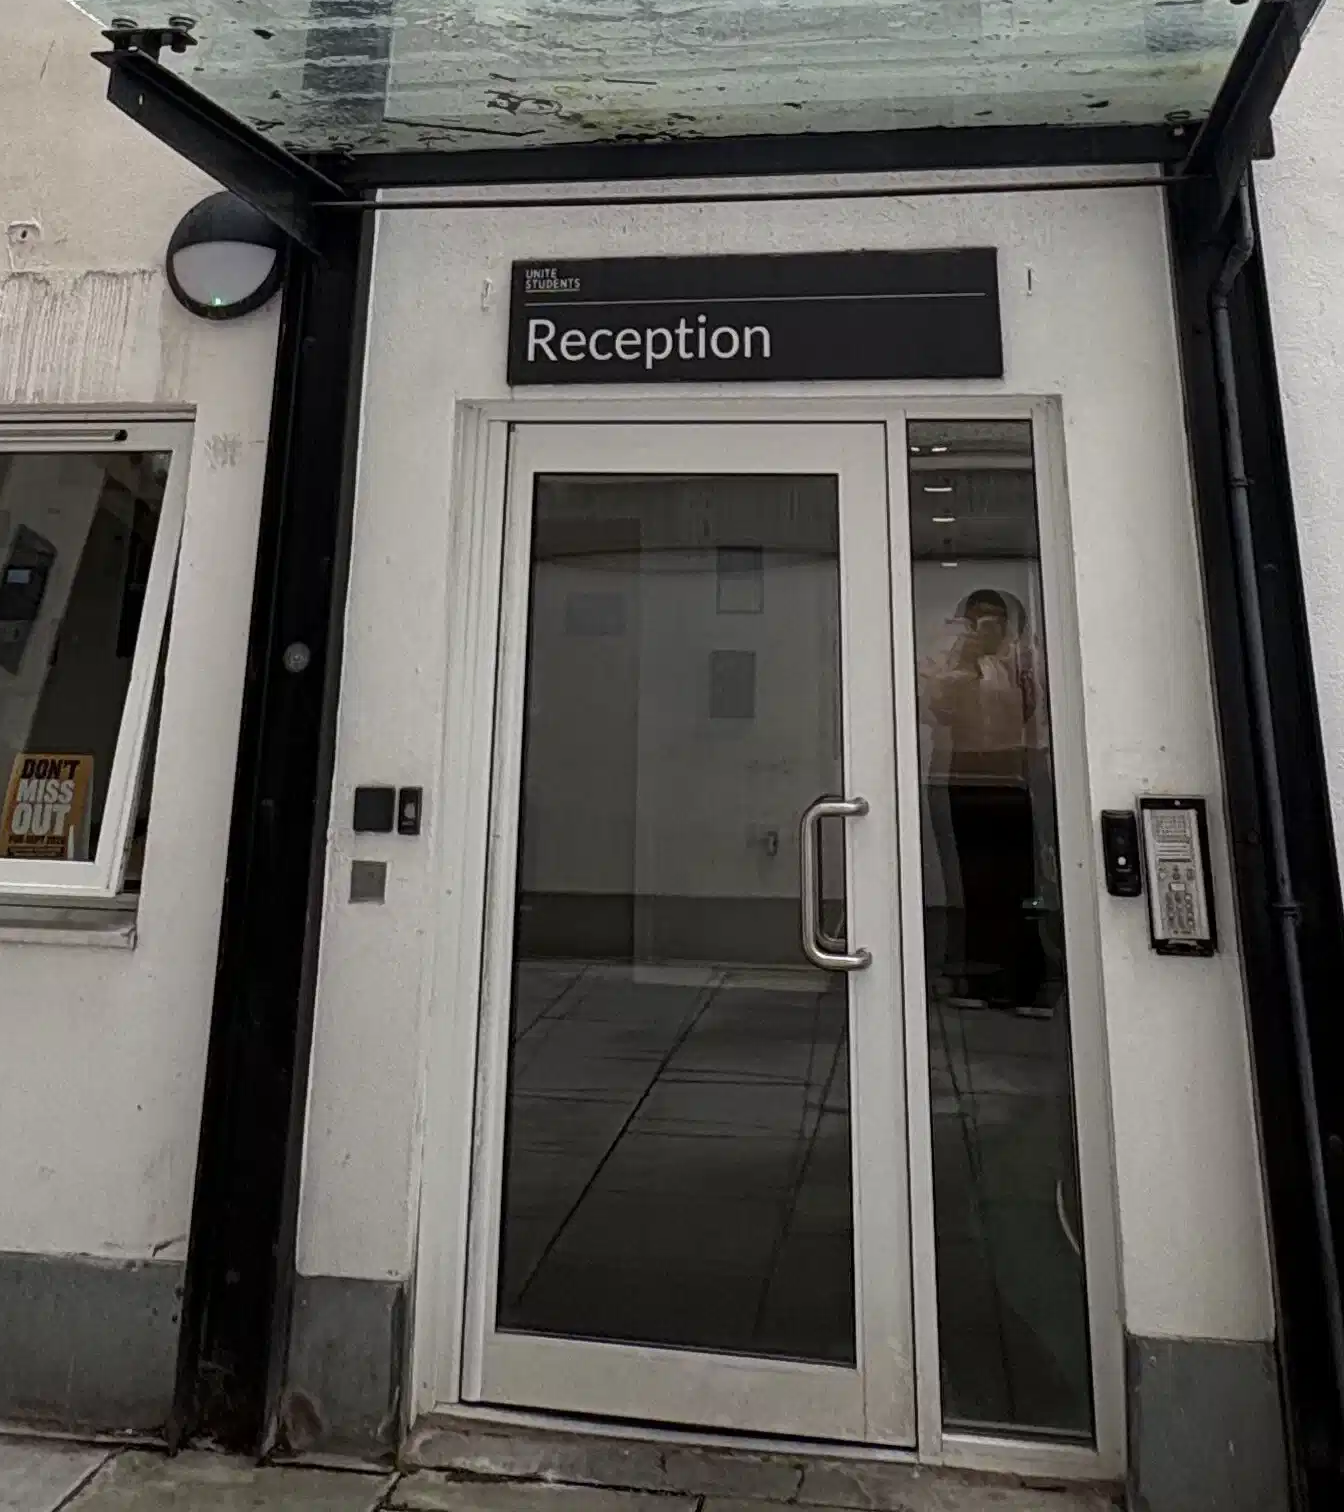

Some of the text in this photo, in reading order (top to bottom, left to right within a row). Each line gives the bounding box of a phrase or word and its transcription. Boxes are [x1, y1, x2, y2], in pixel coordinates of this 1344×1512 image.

[525, 268, 558, 279] UNITE
[525, 278, 581, 290] STUDENTS
[527, 314, 772, 370] Reception
[20, 758, 81, 780] DON'T
[17, 779, 76, 804] MISS
[11, 803, 72, 836] OUT
